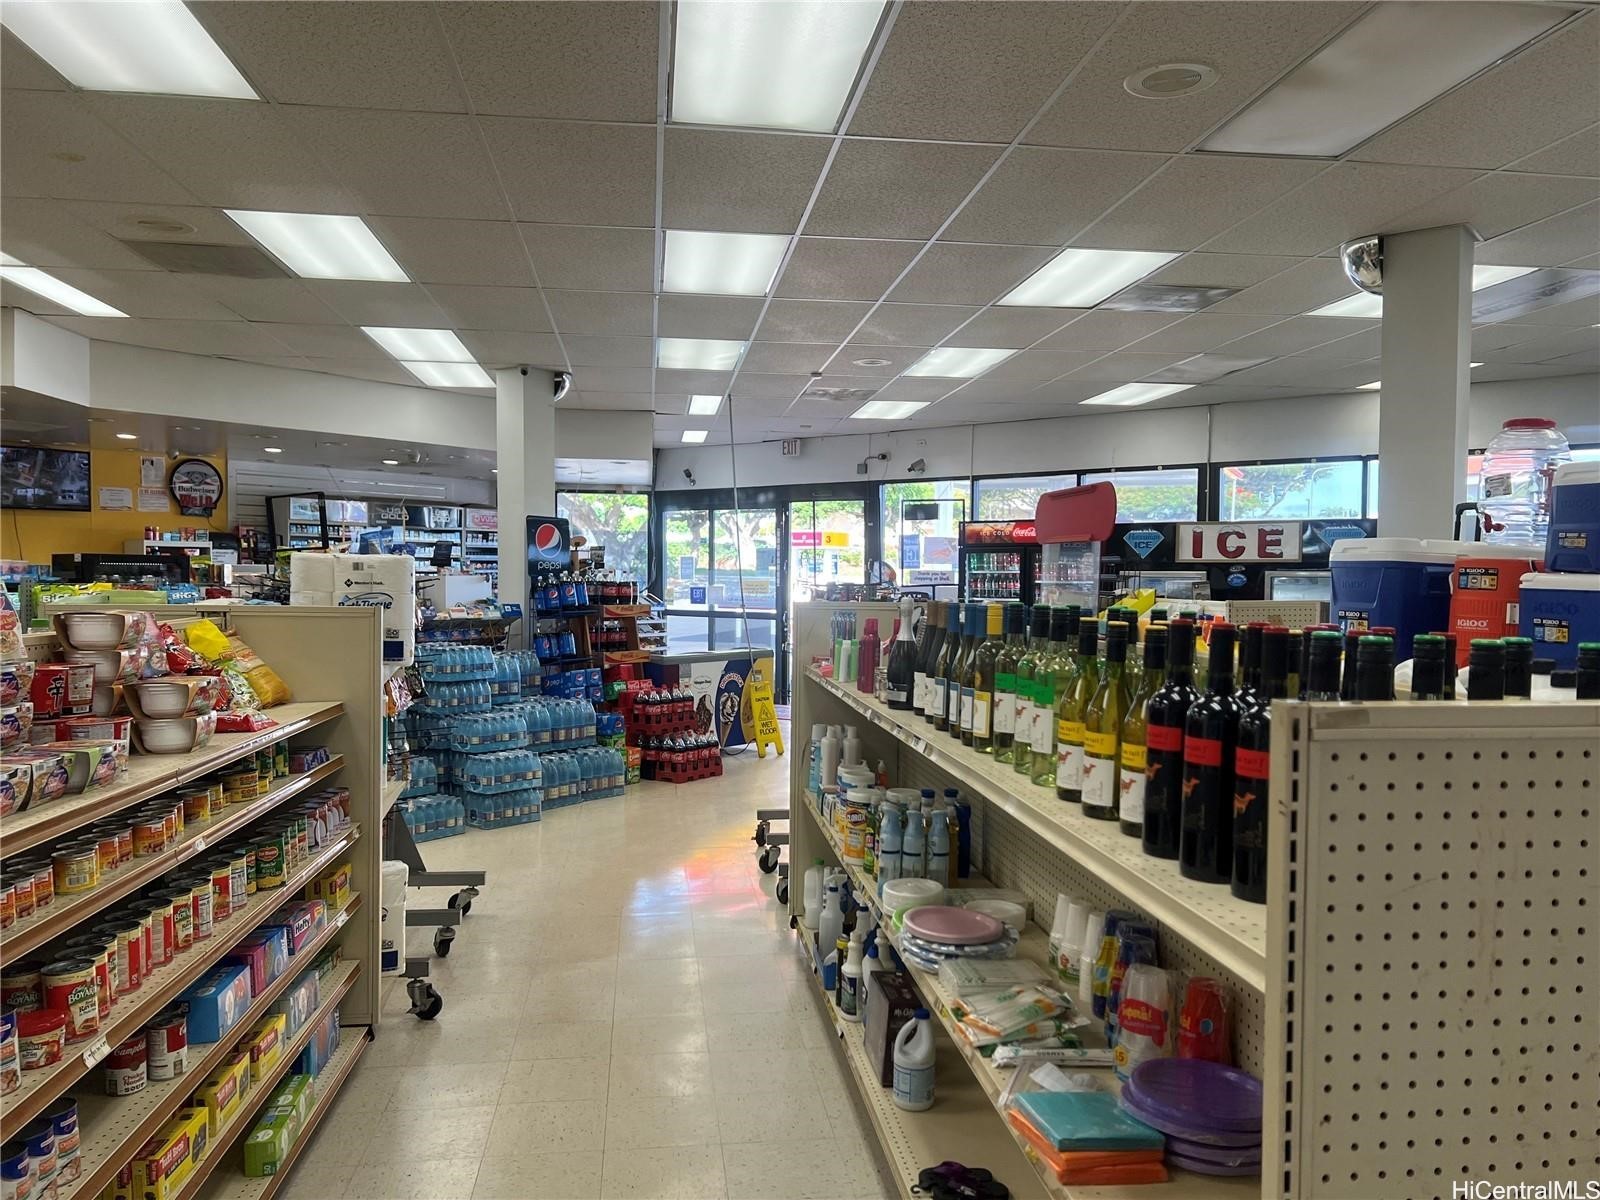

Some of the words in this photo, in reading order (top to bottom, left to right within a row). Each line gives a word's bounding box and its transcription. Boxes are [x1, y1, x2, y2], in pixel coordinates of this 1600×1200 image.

[782, 440, 797, 455] EXIT
[178, 485, 215, 494] Budweiser
[825, 535, 831, 544] 3
[1191, 526, 1284, 560] ICE
[1134, 541, 1153, 549] ICE
[537, 561, 562, 570] pepsi
[693, 589, 704, 597] EBT
[1457, 618, 1489, 627] IGLOO
[759, 728, 777, 736] FLOOR
[295, 918, 311, 936] Hefty
[124, 1083, 145, 1093] SOUP
